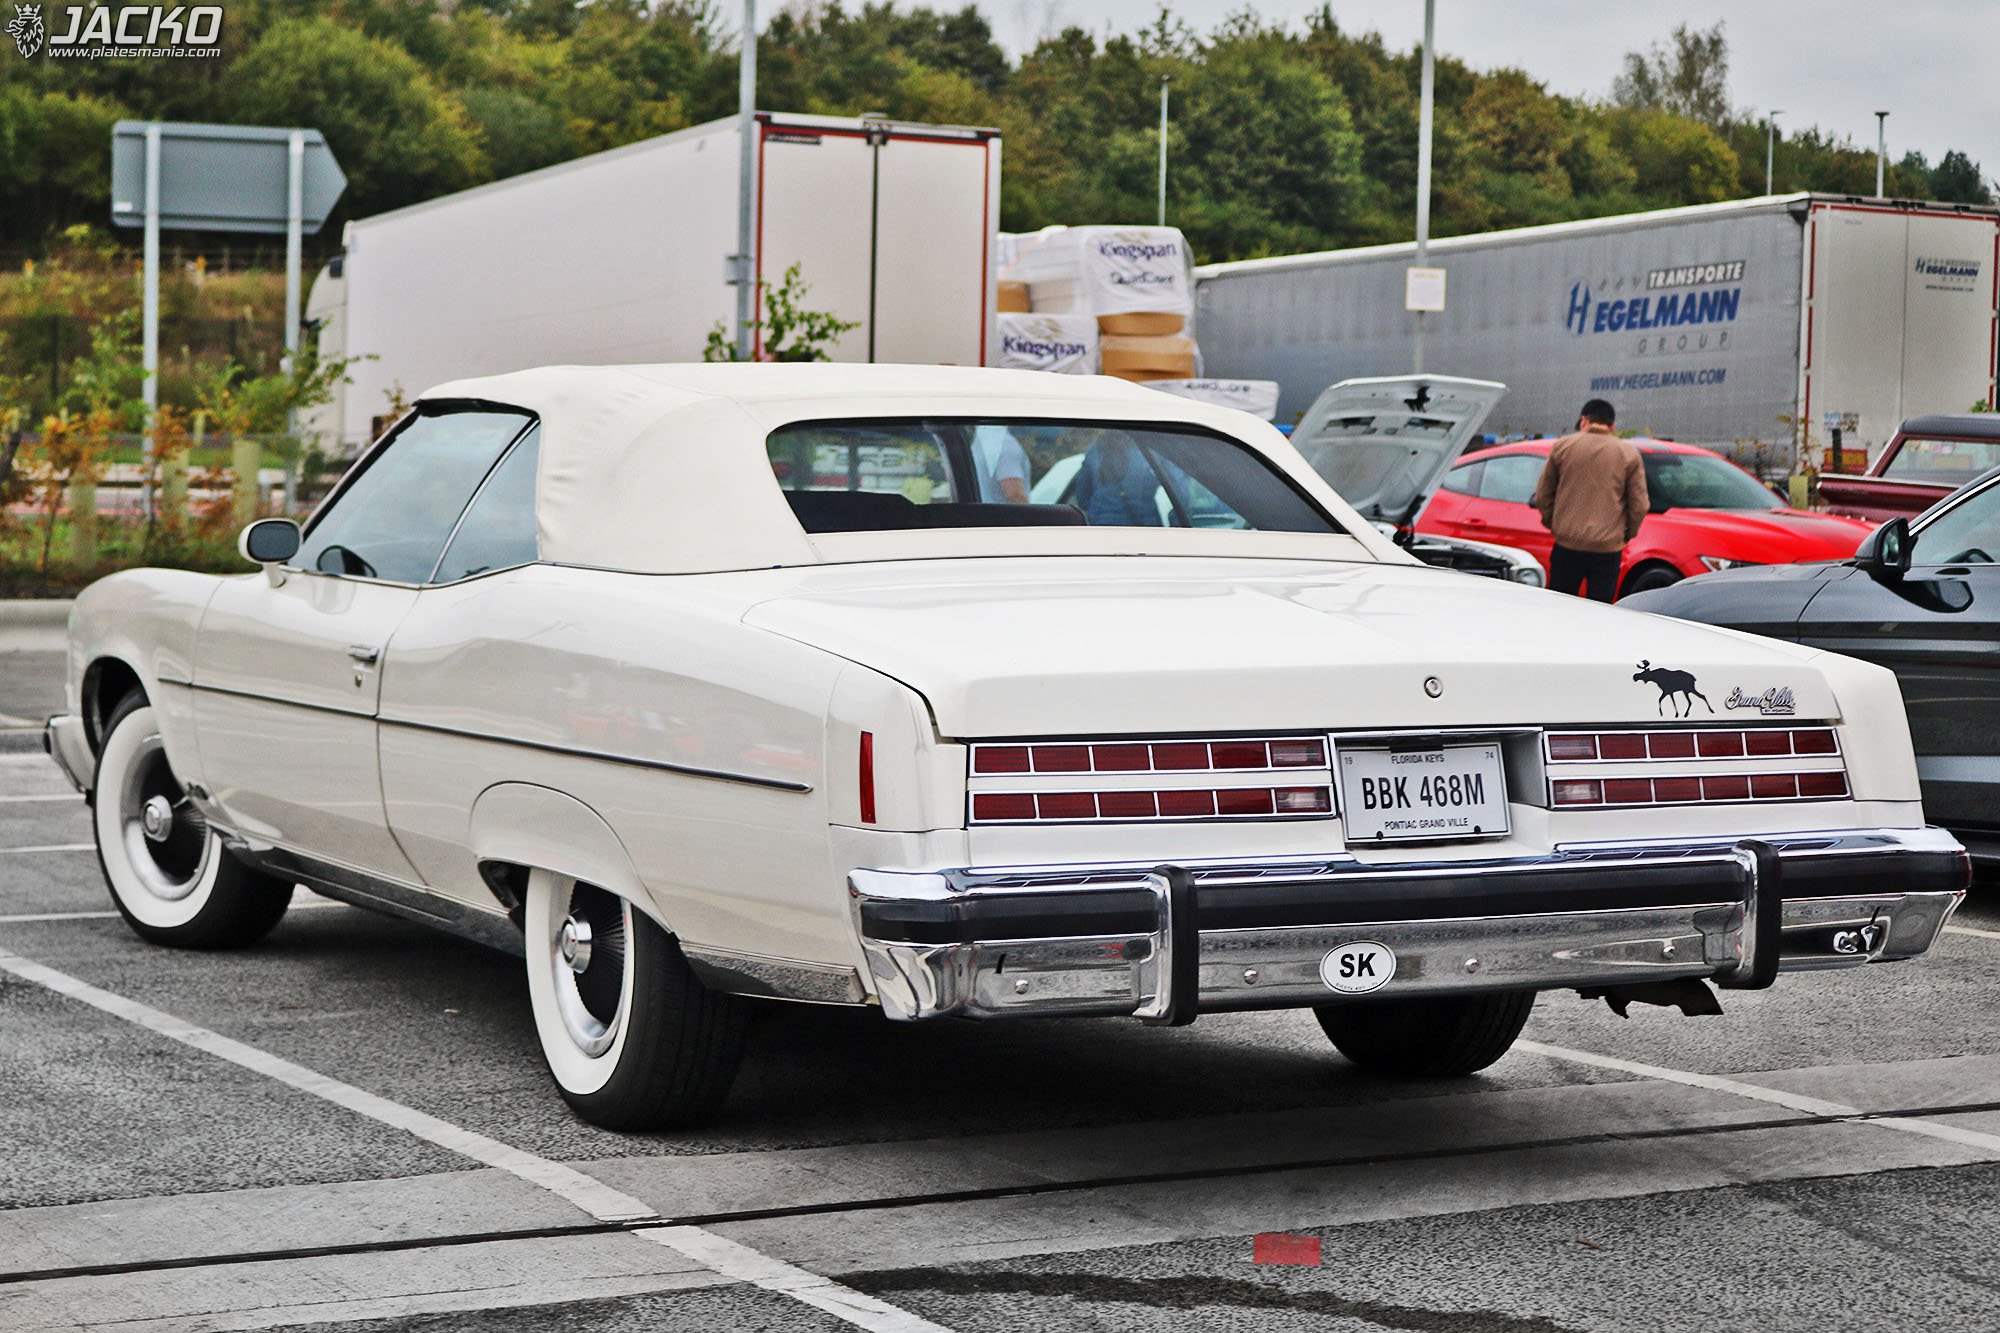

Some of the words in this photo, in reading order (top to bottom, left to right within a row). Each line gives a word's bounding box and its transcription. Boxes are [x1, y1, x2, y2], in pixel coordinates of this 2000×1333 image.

[1099, 242, 1177, 261] Kingspan
[1649, 262, 1744, 289] TRANSPORTE
[1567, 281, 1740, 334] HEGELMANN
[1003, 335, 1086, 361] Kingspan
[1590, 368, 1726, 391] WWW.HEGELMANN.COM
[1391, 755, 1423, 764] FLORIDA
[1425, 754, 1446, 763] KEYS
[1485, 751, 1494, 760] 74
[1361, 776, 1412, 810] BBK
[1420, 773, 1485, 808] 468M
[1385, 820, 1418, 830] PONTIAC
[1419, 818, 1446, 828] GRAND
[1447, 817, 1469, 827] VILLE
[1339, 952, 1377, 978] SK
